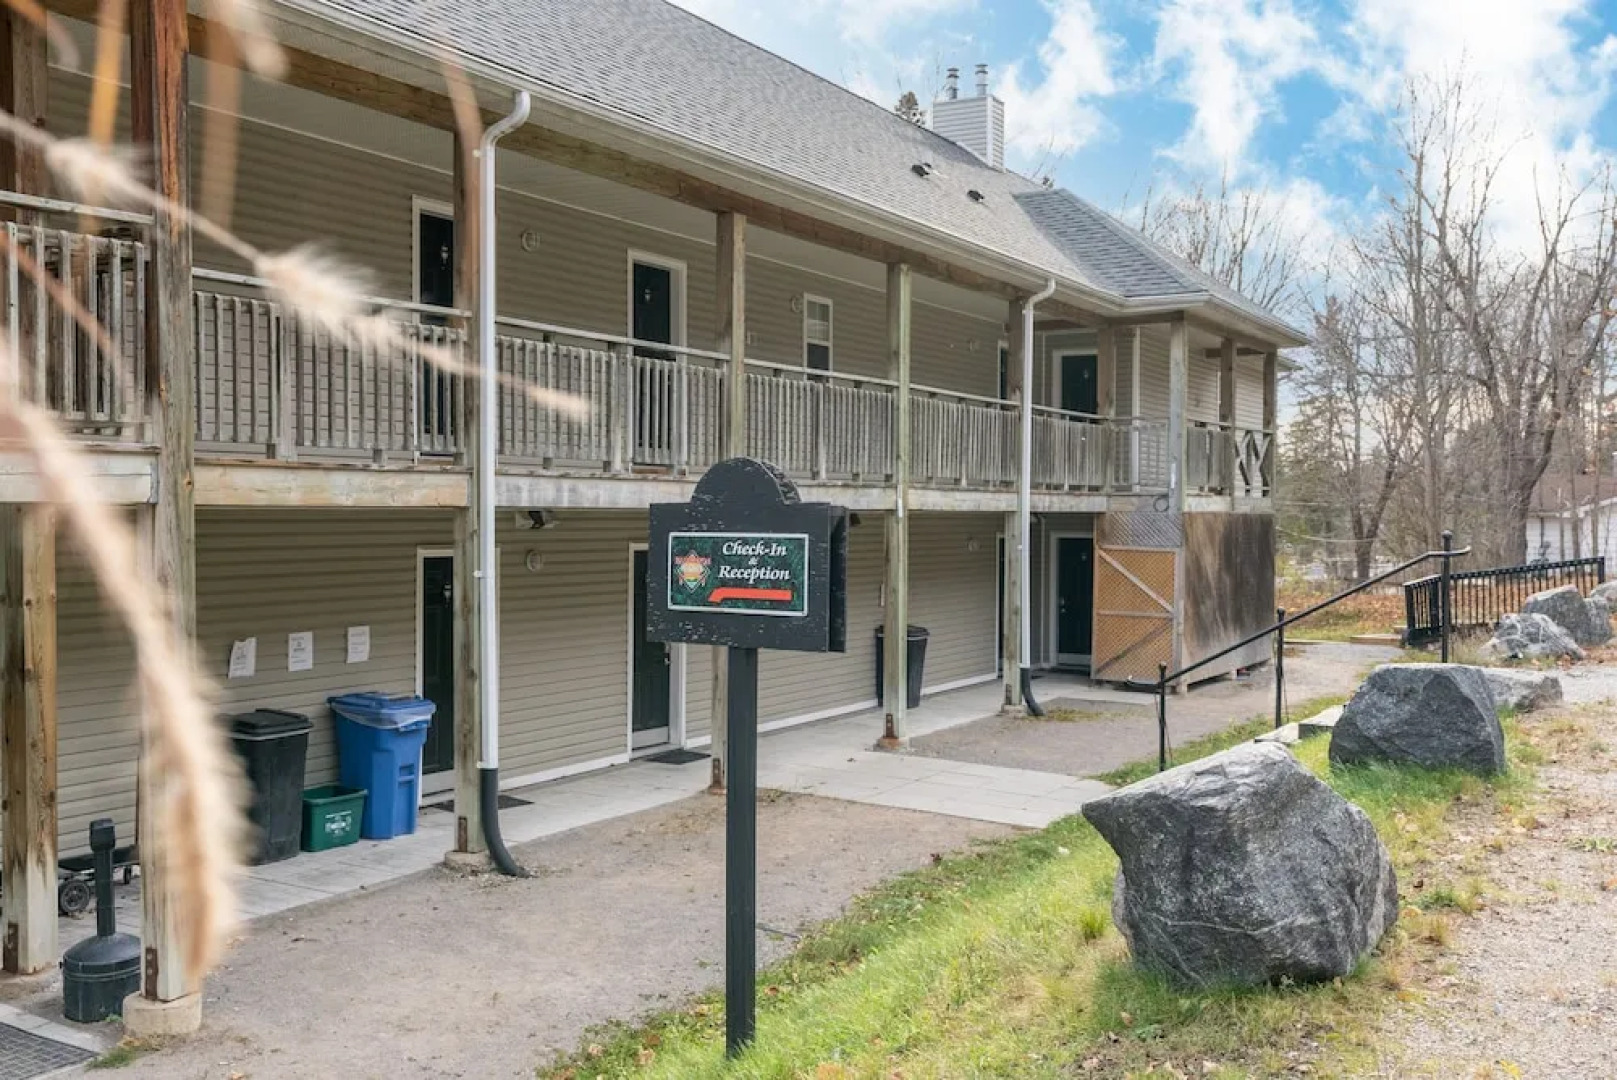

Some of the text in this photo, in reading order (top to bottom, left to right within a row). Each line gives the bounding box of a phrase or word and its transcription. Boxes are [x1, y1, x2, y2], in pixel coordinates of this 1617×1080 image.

[722, 540, 787, 556] Check-In
[748, 557, 758, 565] &
[718, 565, 790, 584] Reception
